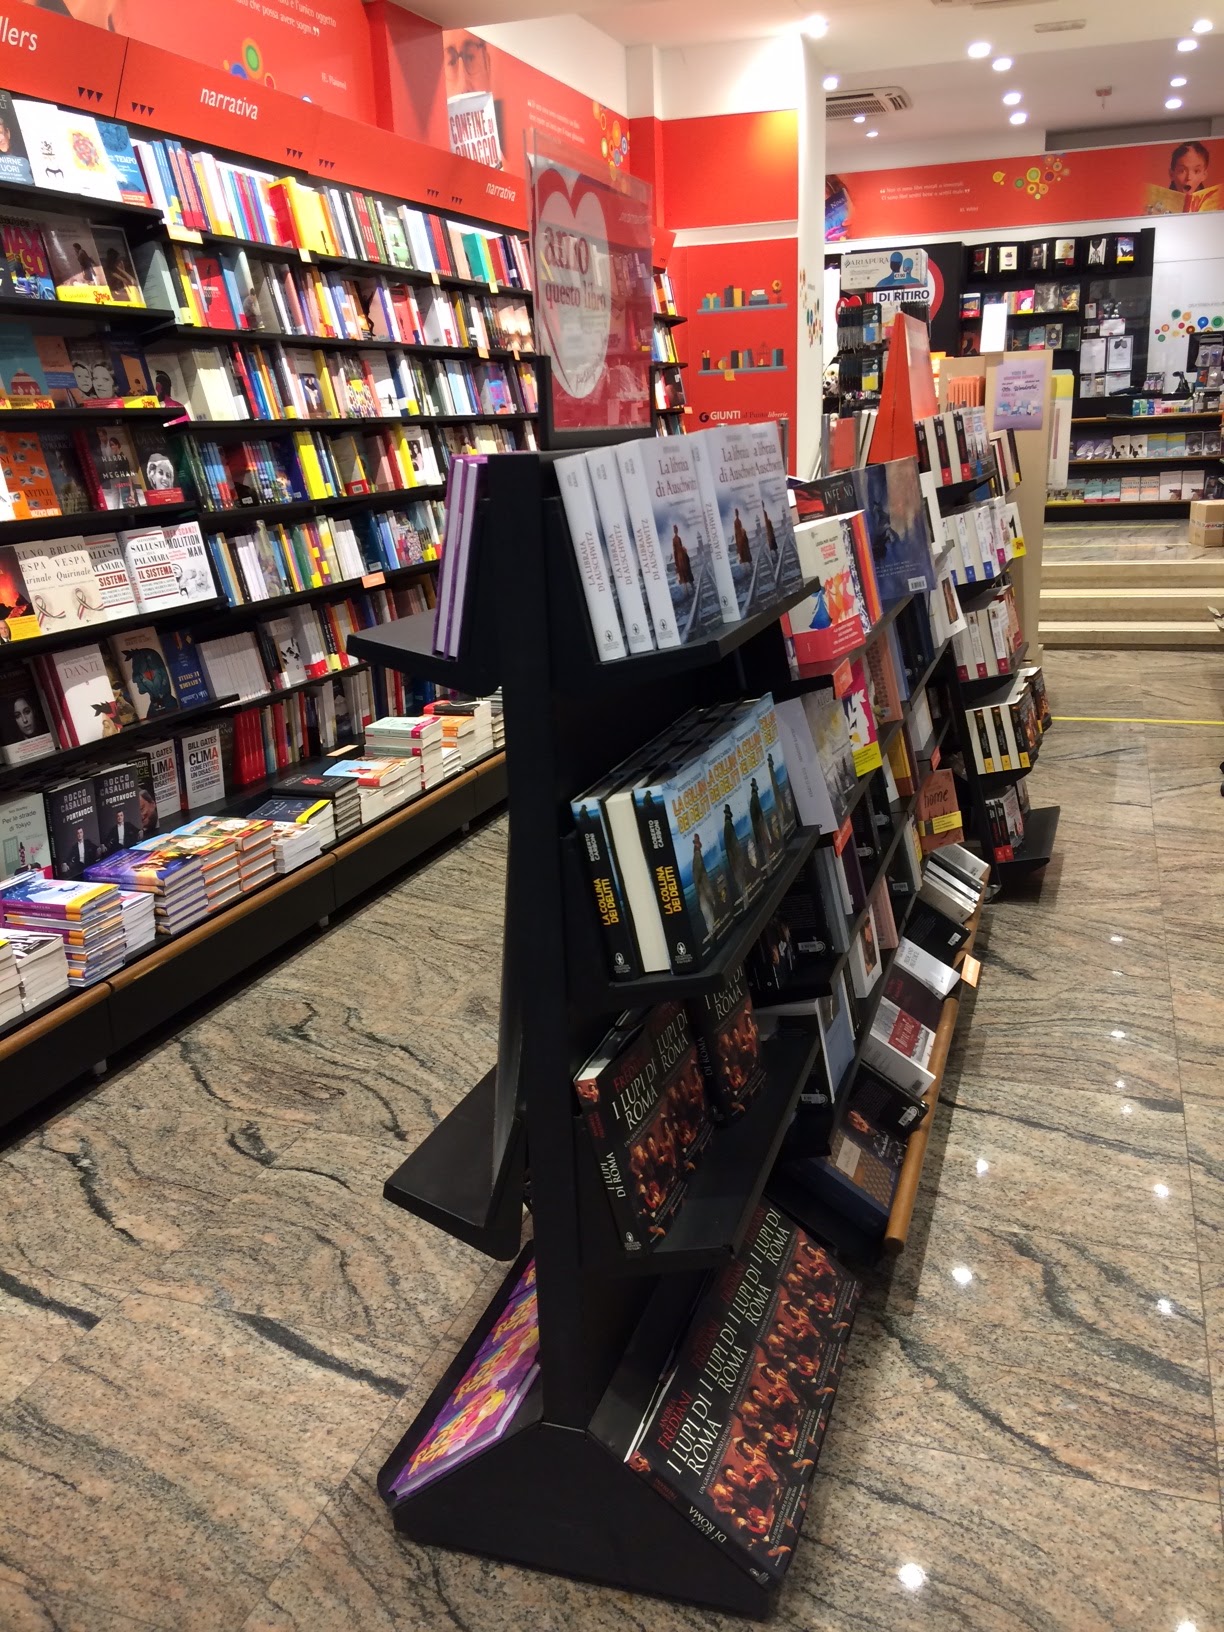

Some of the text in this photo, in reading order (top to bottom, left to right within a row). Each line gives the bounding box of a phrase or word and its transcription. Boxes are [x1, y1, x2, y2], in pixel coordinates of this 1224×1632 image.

[200, 86, 259, 120] narrativa
[450, 109, 486, 145] CONFINE
[115, 155, 137, 165] TEMPO
[485, 181, 516, 202] narrativa
[850, 257, 889, 266] ARIAPURA
[879, 289, 930, 302] DI RITIRO
[710, 410, 741, 420] GIUNTI
[101, 454, 127, 463] HARRY
[658, 459, 671, 476] La
[102, 470, 136, 480] MEGHAN
[24, 488, 53, 498] ITALIAN
[655, 480, 666, 498] di
[824, 485, 854, 504] INFENO
[705, 502, 722, 552] AUSCHWITZ
[49, 543, 84, 556] BRUNO
[166, 535, 200, 549] MOLITION
[187, 546, 204, 558] MAN
[637, 528, 651, 574] LA LIBRAIA
[641, 518, 660, 581] DI AUSCHWITZ
[16, 548, 44, 560] RUNO
[54, 556, 87, 567] VESPA
[89, 547, 120, 560] ALLUSTI
[134, 553, 170, 566] PALAMARA
[580, 540, 596, 587] LA LIBRAIA
[585, 530, 606, 593] DI AUSCHWITZ
[608, 533, 623, 579] LA LIBRAIA
[613, 523, 633, 585] DI AUSCHWITZ
[20, 561, 47, 573] ESPA
[56, 567, 91, 582] Quirinale
[92, 561, 124, 573] ALAMARA
[137, 565, 173, 580] IL SISTEMA
[26, 573, 52, 585] irinale
[99, 574, 128, 588] SISTEMA
[63, 661, 102, 679] DANTE
[155, 746, 173, 758] GATES
[187, 735, 217, 751] BILL GATES
[741, 729, 762, 754] COLLIN
[151, 757, 174, 777] LIMA
[189, 747, 218, 766] CLIMA
[713, 751, 738, 780] COLLIN
[100, 780, 135, 797] CASALINO
[103, 773, 130, 788] ROCCO
[60, 795, 92, 813] CASALINO
[63, 788, 87, 804] ROCCO
[105, 791, 136, 805] PORTAVOCE
[671, 795, 685, 818] LA
[683, 778, 708, 809] COLLIN
[923, 789, 949, 809] home
[19, 810, 37, 820] strade
[66, 806, 94, 822] PORTAVOCE
[15, 821, 31, 829] Tokyo
[648, 819, 659, 849] ROBERTO
[653, 819, 664, 849] CARBONI
[585, 833, 596, 862] ROBERTO
[590, 832, 601, 861] CARBONI
[656, 865, 674, 915] LA COLLINA
[664, 865, 683, 913] DEI DELITTI
[593, 877, 612, 926] LA COLLINA
[601, 878, 620, 924] DEI DELITTI
[715, 984, 743, 1020] ROMA
[656, 1008, 688, 1055] LUPI DI
[660, 1033, 689, 1073] ROMA
[611, 1058, 658, 1121] I LUPI DI
[624, 1086, 659, 1131] ROMA
[600, 1162, 613, 1184] LUPI
[605, 1151, 627, 1198] DI ROMA
[750, 1207, 781, 1264] I LUPI DI
[766, 1227, 790, 1267] ROMA
[728, 1263, 762, 1325] I LUPI DI
[744, 1284, 772, 1328] ROMA
[699, 1322, 738, 1393] I LUPI DI
[717, 1344, 748, 1395] ROMA
[657, 1390, 693, 1451] FREDIANI
[666, 1392, 713, 1475] I LUPI DI
[686, 1420, 723, 1477] ROMA
[689, 1505, 728, 1544] DI ROMA
